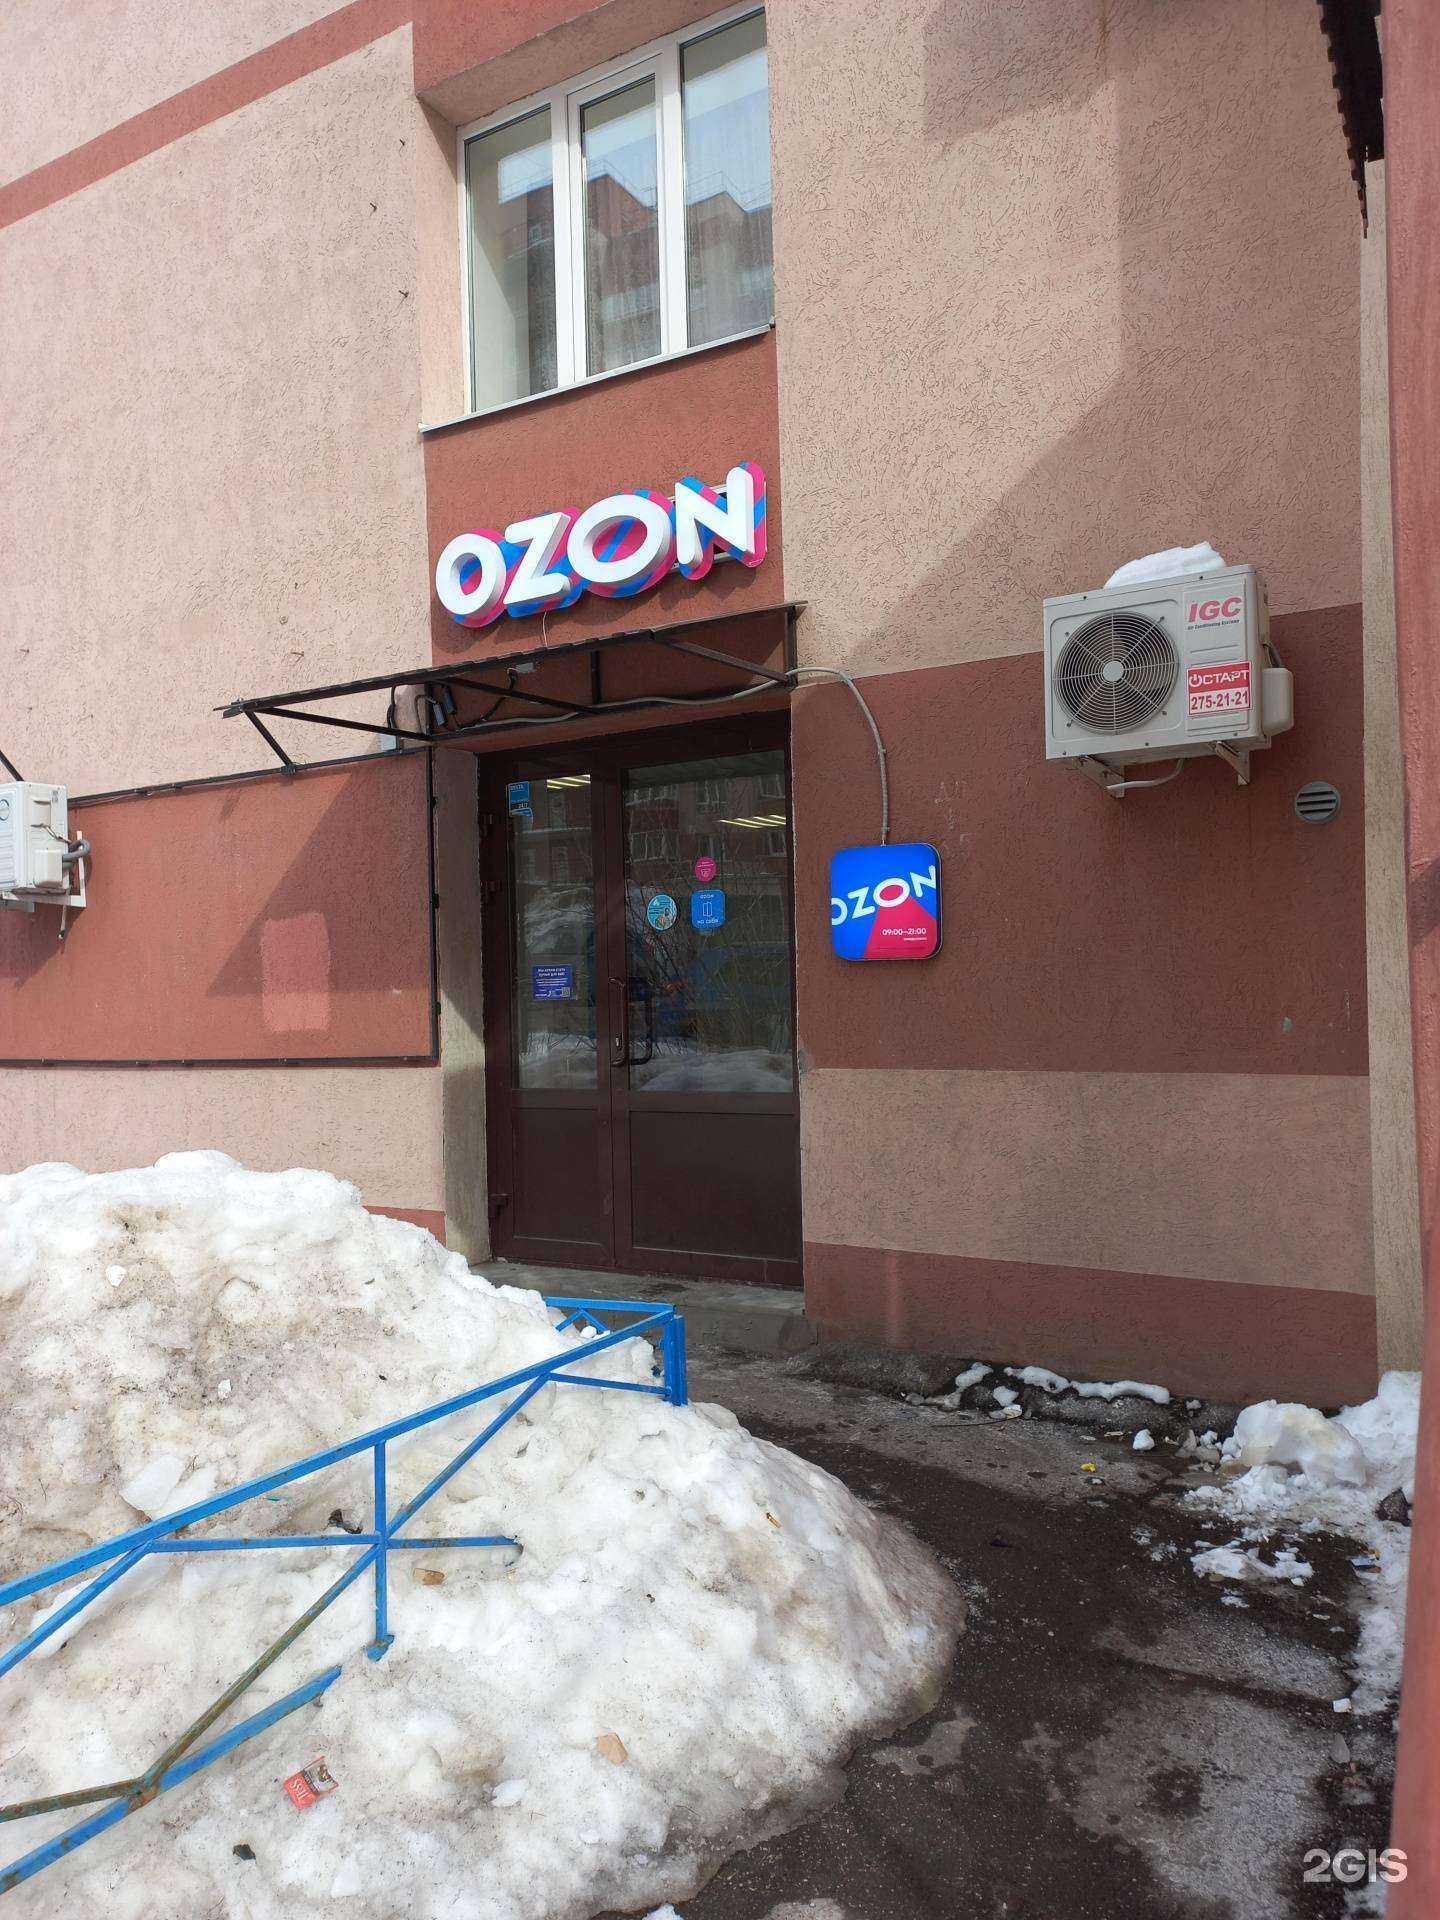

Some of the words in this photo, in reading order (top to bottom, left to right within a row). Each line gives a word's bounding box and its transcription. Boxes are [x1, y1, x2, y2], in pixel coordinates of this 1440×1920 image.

[436, 462, 767, 627] OZON
[1188, 597, 1242, 622] IGC
[1191, 690, 1248, 710] 275-21-21
[831, 865, 937, 926] OZON
